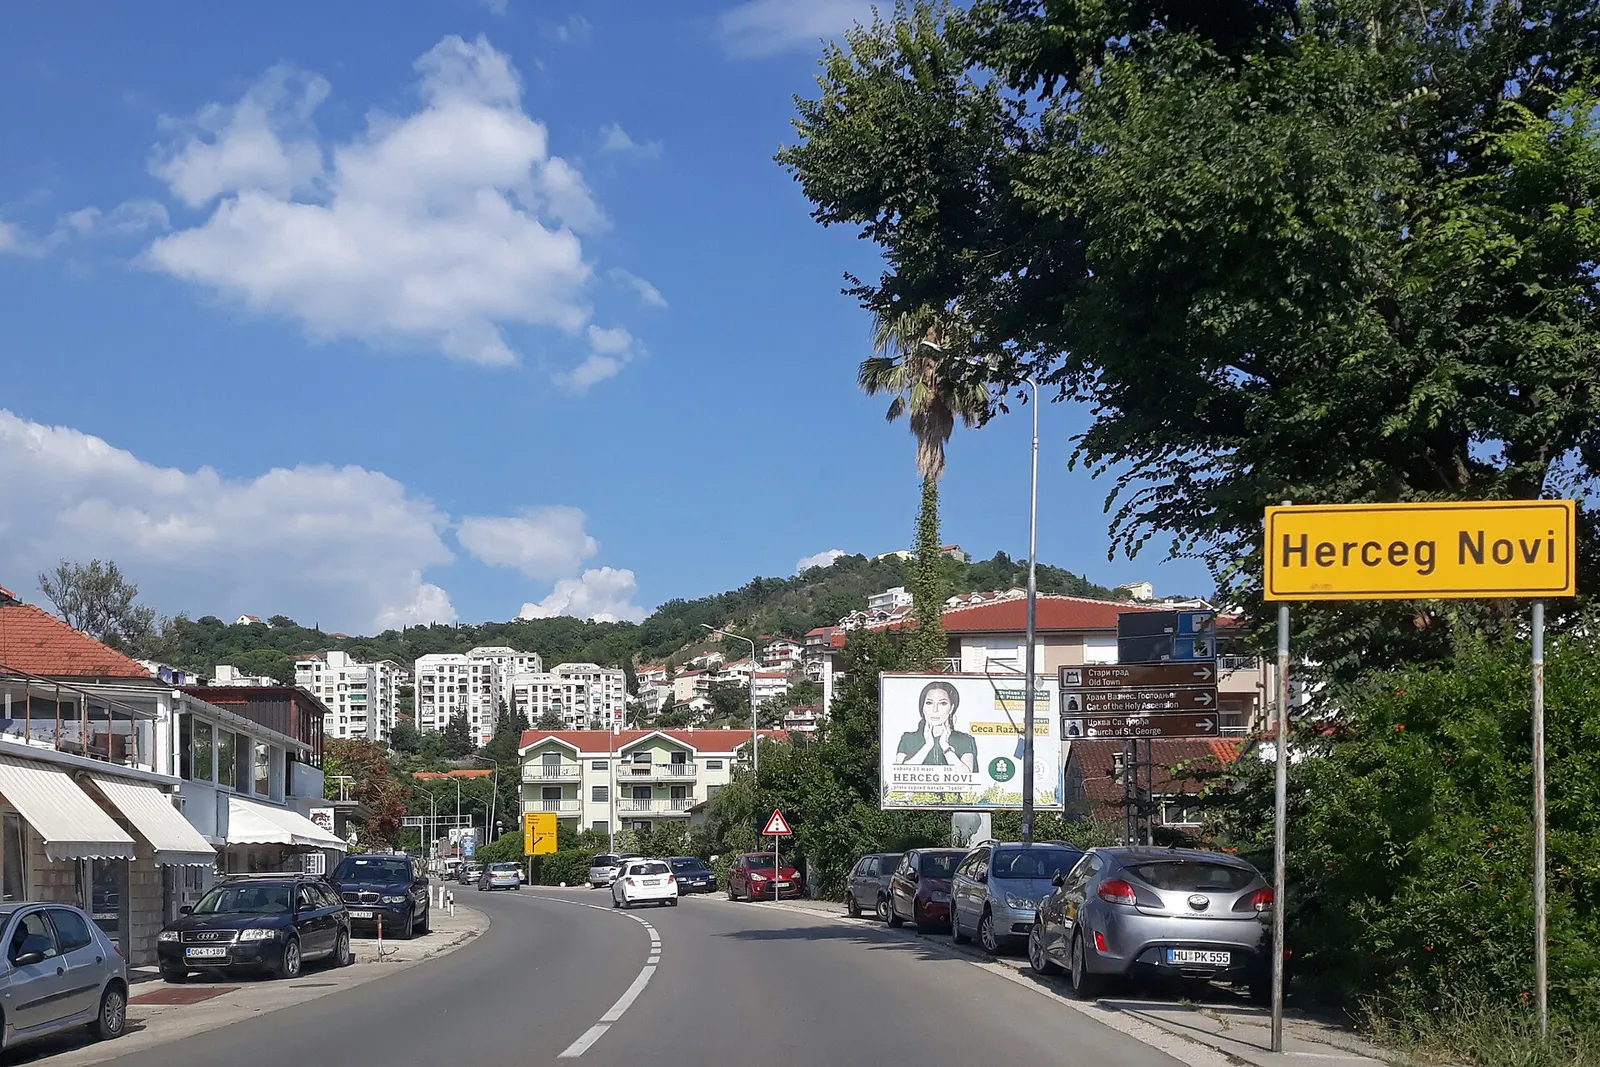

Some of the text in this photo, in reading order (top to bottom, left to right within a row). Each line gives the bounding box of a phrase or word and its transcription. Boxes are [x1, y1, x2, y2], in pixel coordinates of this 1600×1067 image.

[1282, 530, 1555, 576] Herceg Novi
[1088, 669, 1111, 677] Стари
[1086, 693, 1106, 701] Храм
[1086, 703, 1101, 711] Cat.
[1111, 702, 1124, 710] the
[1125, 702, 1141, 711] Holy
[1141, 701, 1179, 710] Ascension
[971, 724, 994, 733] Ceca
[1087, 727, 1114, 736] Church
[1123, 727, 1133, 735] St.
[1135, 727, 1162, 736] George
[893, 773, 972, 782] HERCEG NOVI
[1173, 951, 1229, 963] HU PK 555
